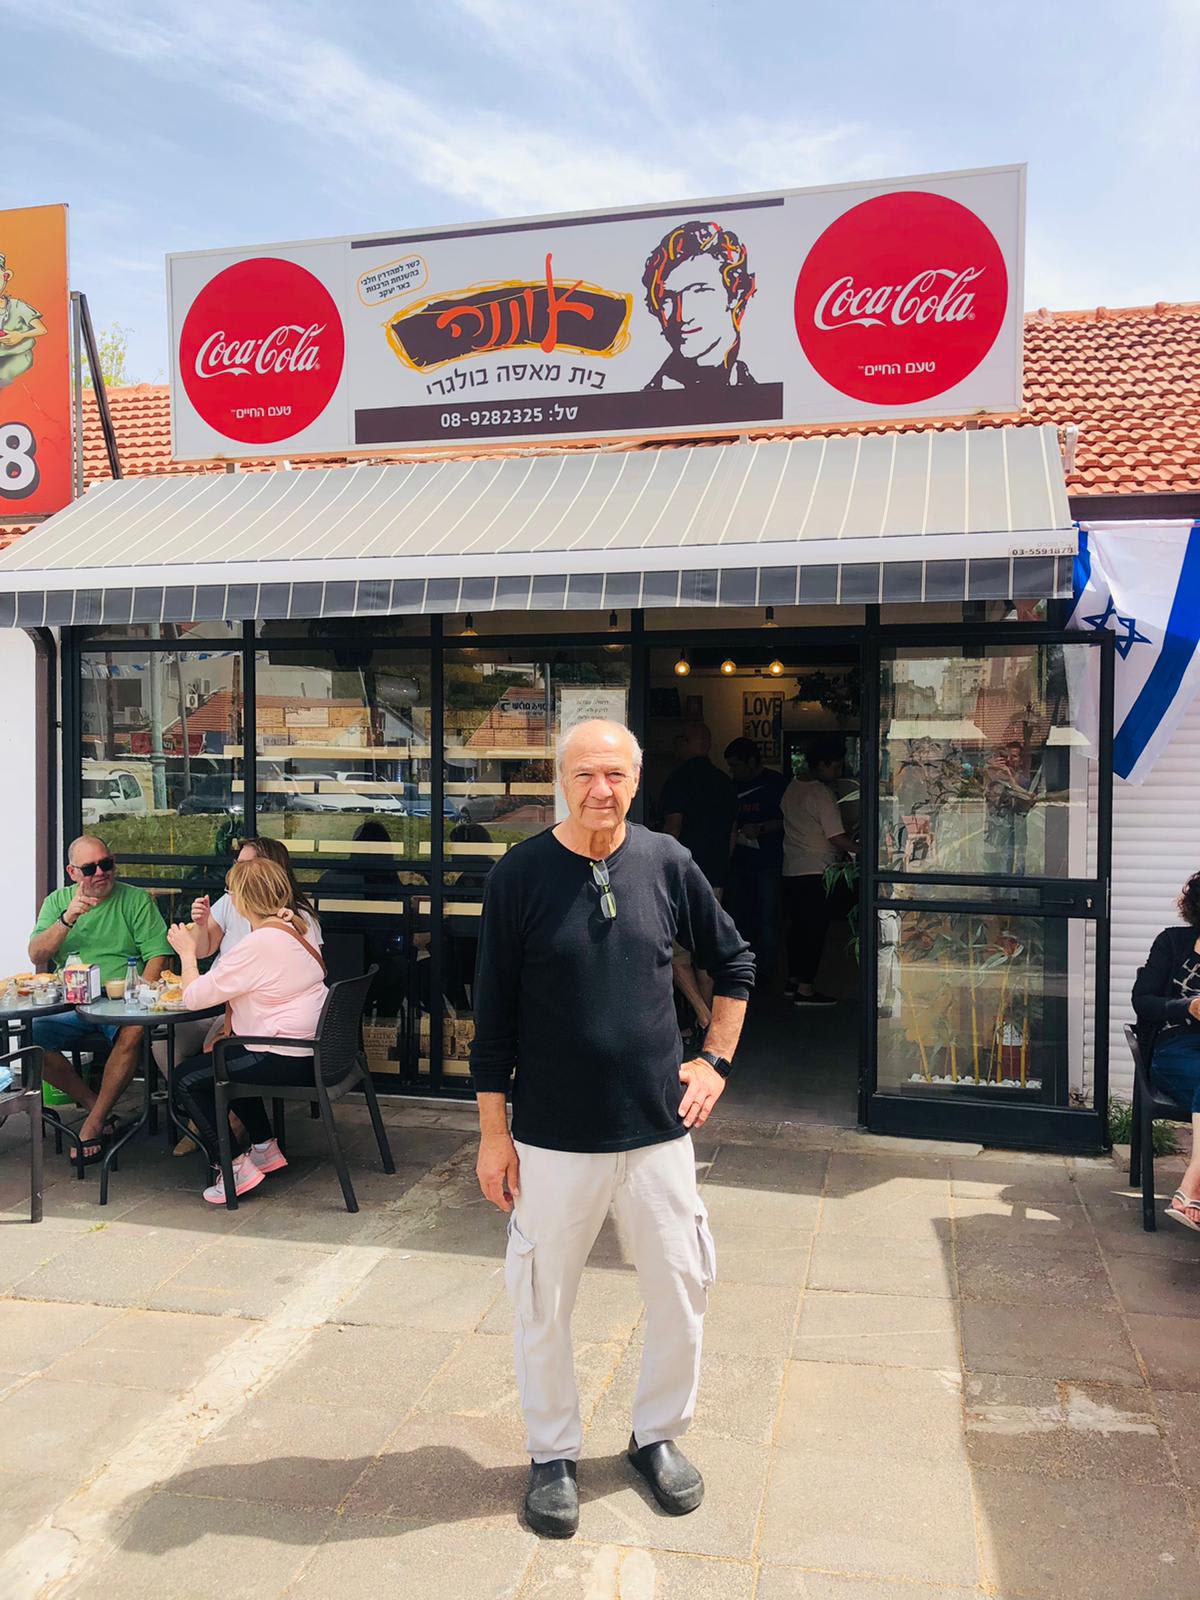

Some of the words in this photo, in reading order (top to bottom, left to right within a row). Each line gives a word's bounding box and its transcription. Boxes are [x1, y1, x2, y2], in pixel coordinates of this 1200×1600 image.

[405, 260, 420, 269] כשר
[360, 276, 377, 286] חלבי
[377, 265, 404, 282] למהדרין
[366, 279, 390, 293] הרבנות
[379, 287, 396, 298] יעקב
[396, 282, 411, 291] באר
[814, 266, 986, 331] Coca-Cola
[195, 323, 327, 378] Coca-Cola
[496, 364, 561, 383] מאפה
[905, 361, 936, 373] טעם
[426, 368, 489, 395] בולגרי
[567, 366, 607, 390] בית
[267, 405, 292, 417] טעם
[440, 409, 543, 428] 08-9282325
[549, 403, 579, 422] טל:
